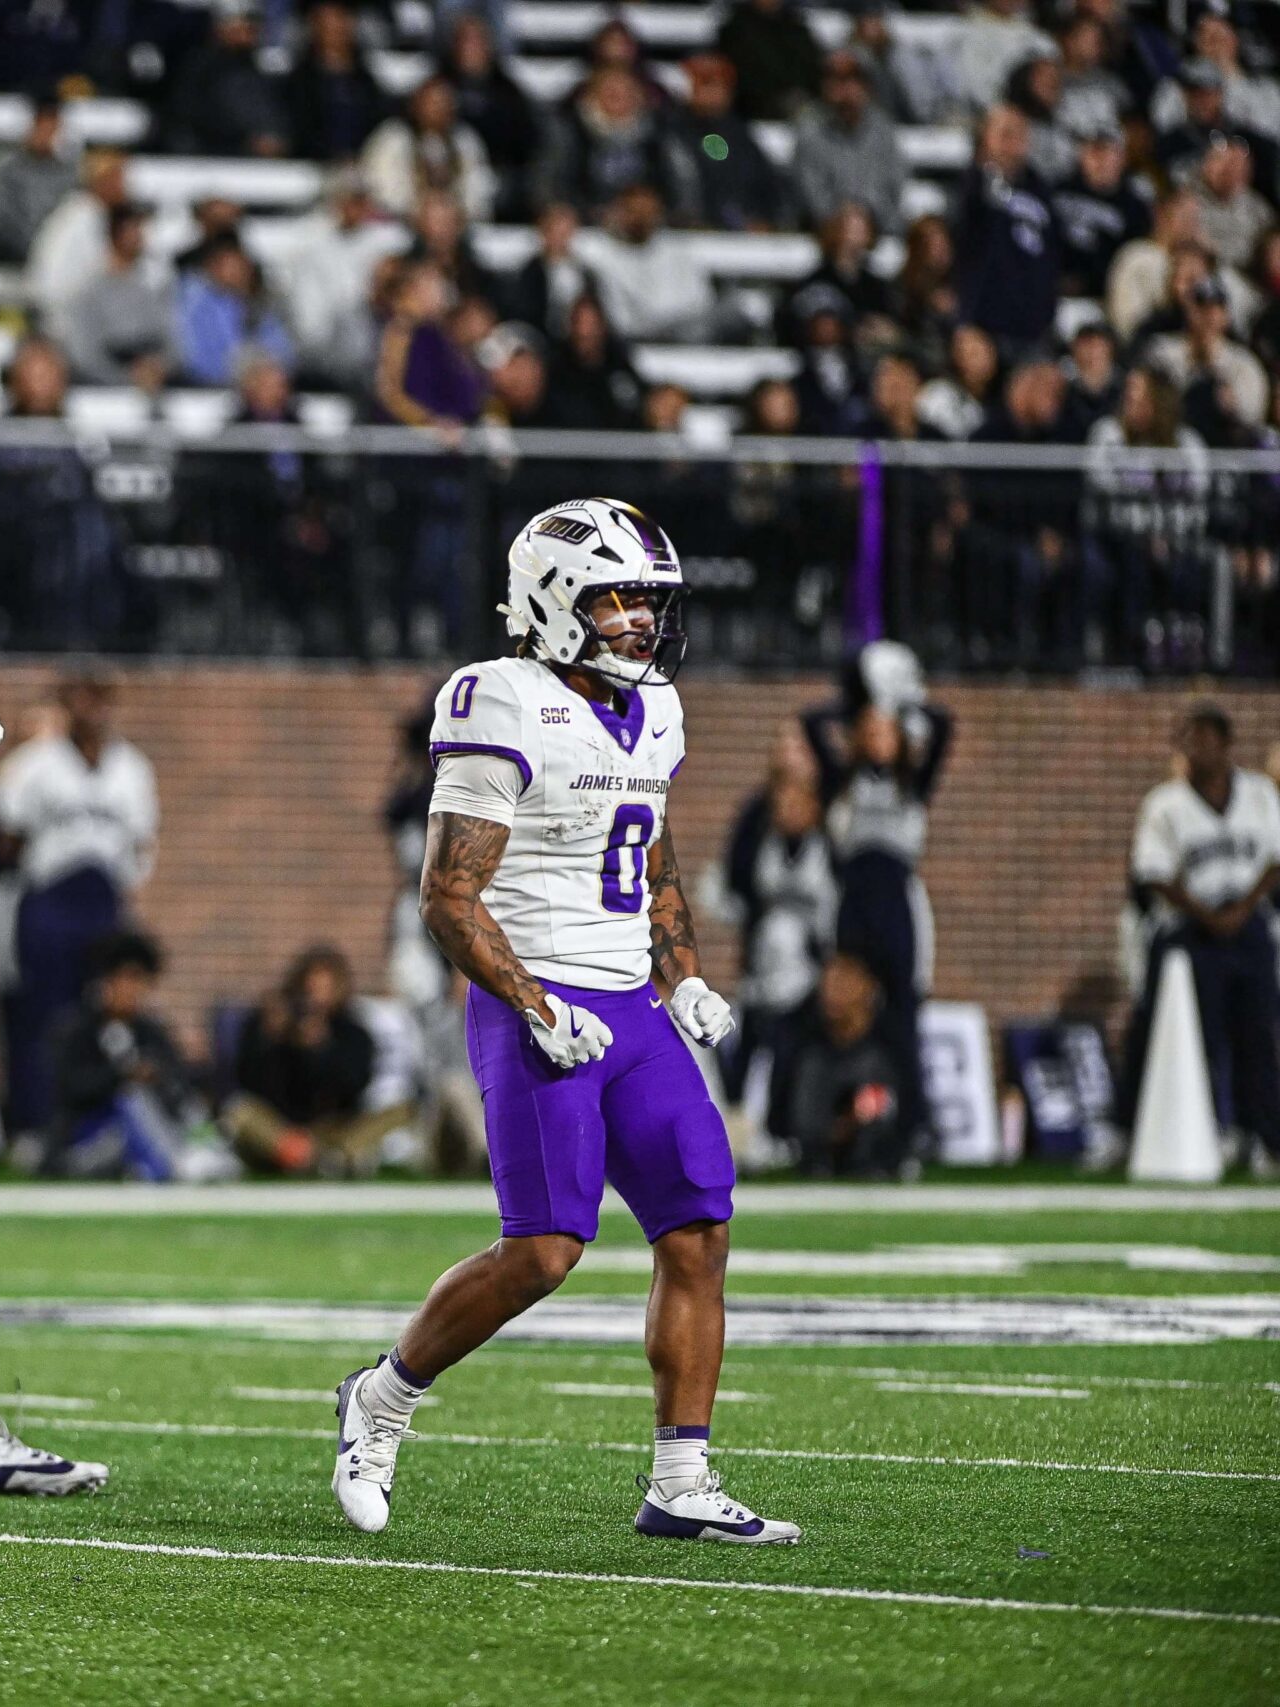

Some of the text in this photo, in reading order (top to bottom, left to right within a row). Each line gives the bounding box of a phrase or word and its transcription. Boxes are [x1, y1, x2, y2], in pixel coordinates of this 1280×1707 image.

[451, 675, 480, 721] 0
[540, 707, 570, 724] SBC
[569, 774, 622, 791] JAMES
[598, 800, 655, 917] 0
